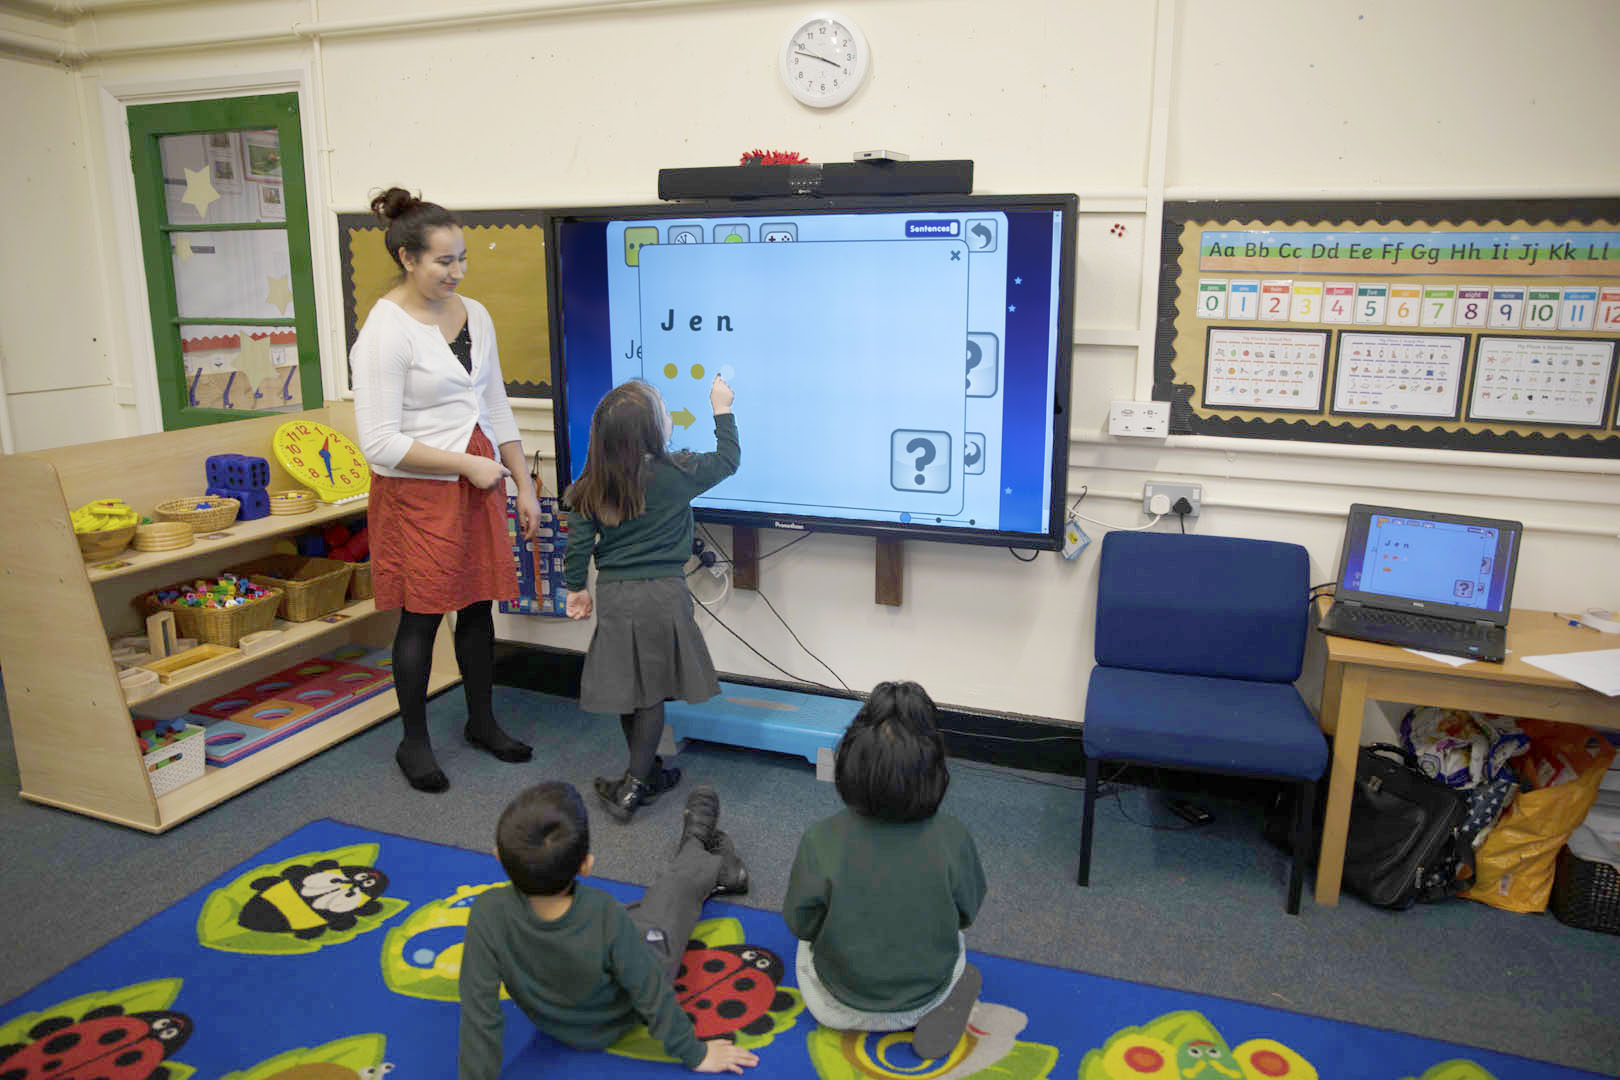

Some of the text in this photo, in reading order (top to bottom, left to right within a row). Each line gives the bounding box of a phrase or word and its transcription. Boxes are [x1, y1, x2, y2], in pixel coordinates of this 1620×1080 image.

[910, 225, 950, 233] Sentences
[1209, 242, 1609, 266] Aa Bb Cc Dd Ee Ff Gg Hh Ii Jj Kk Ll
[1206, 295, 1219, 311] 0
[1241, 296, 1246, 313] 1
[1269, 297, 1281, 313] 2
[1300, 298, 1311, 315] 3
[1331, 299, 1343, 316] 4
[1364, 300, 1377, 317] 5
[1397, 302, 1409, 318] 6
[1431, 302, 1445, 319] 7
[1464, 303, 1478, 320] 8
[1500, 304, 1512, 321] 9
[1531, 304, 1554, 322] 10
[1571, 304, 1584, 322] 11
[287, 431, 300, 441] 11
[296, 425, 311, 435] 12
[314, 427, 323, 435] 1
[329, 433, 341, 443] 2
[285, 444, 301, 454] 10
[344, 445, 355, 455] 3
[293, 457, 304, 467] 9
[353, 458, 362, 467] 4
[308, 468, 320, 478] 8
[340, 474, 351, 484] 6
[349, 468, 360, 478] 5
